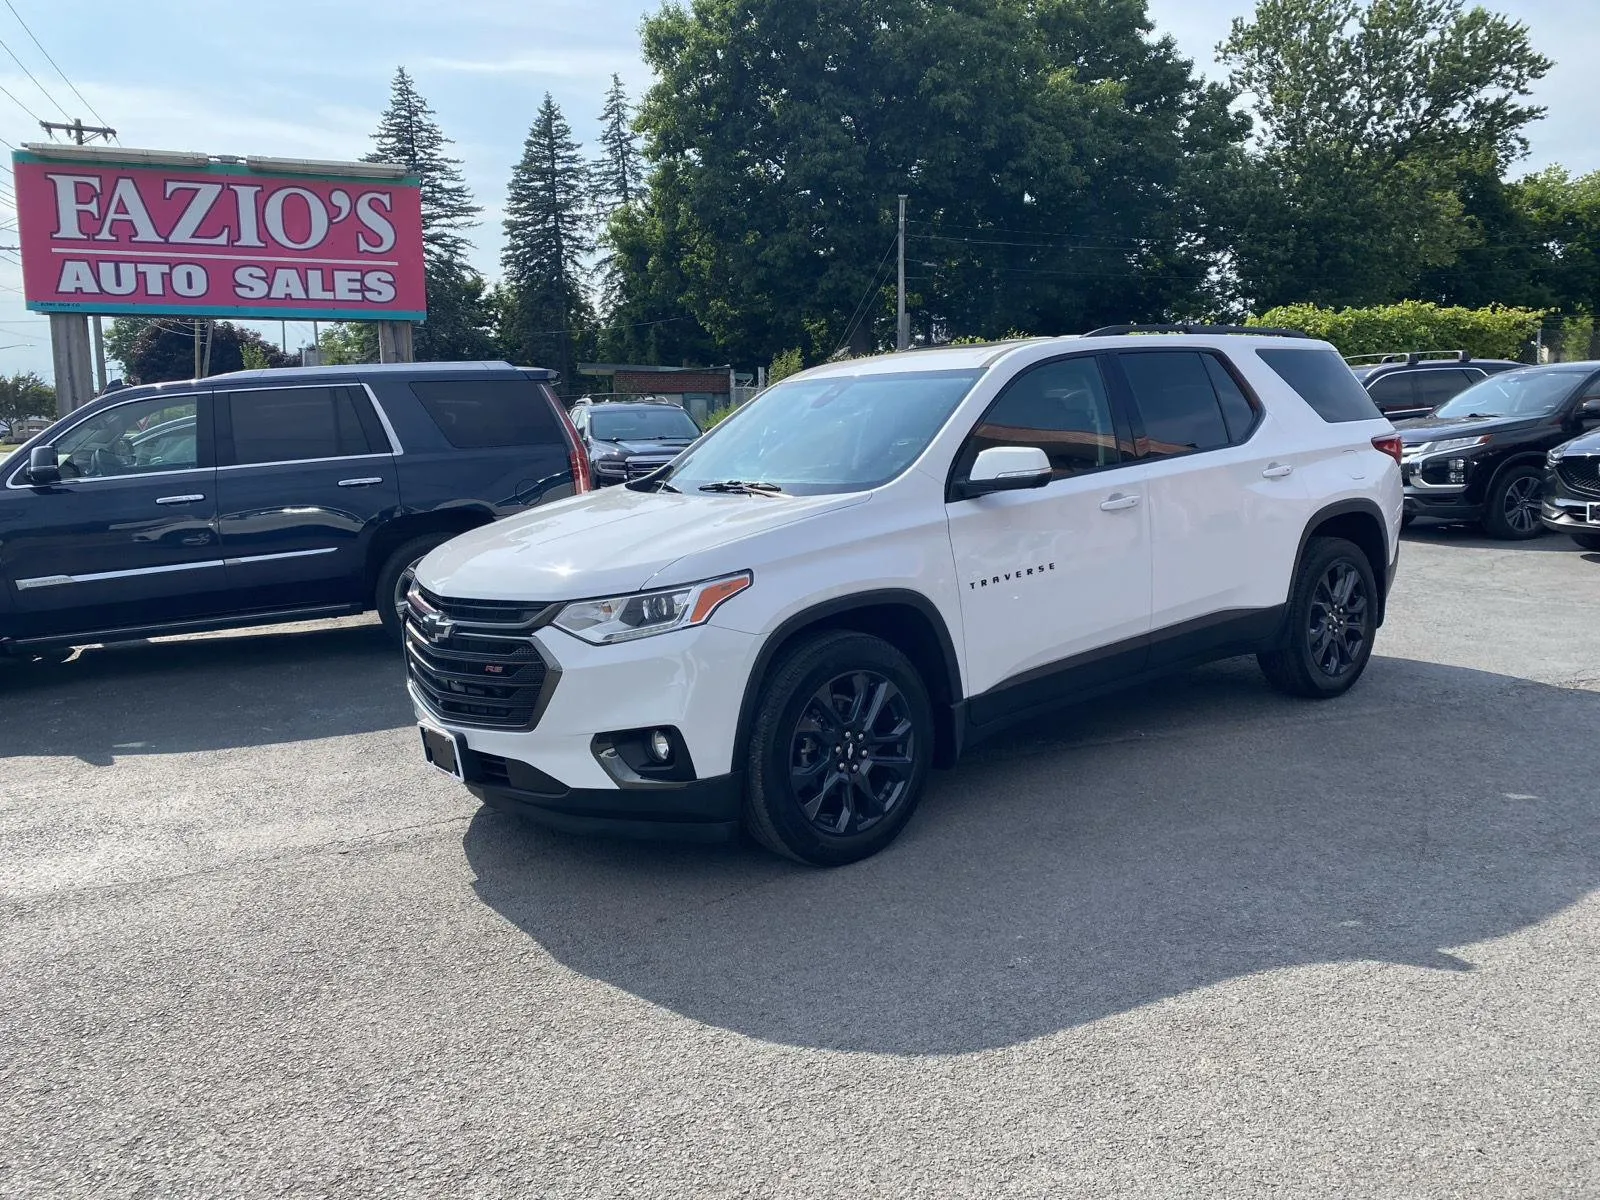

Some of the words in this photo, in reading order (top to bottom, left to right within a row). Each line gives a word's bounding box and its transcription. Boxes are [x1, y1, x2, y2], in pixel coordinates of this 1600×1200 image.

[46, 172, 398, 254] FAZIO'S
[56, 259, 209, 298] AUTO
[233, 265, 398, 302] SALES
[969, 562, 1055, 590] TRAVERSE
[485, 664, 503, 673] RS
